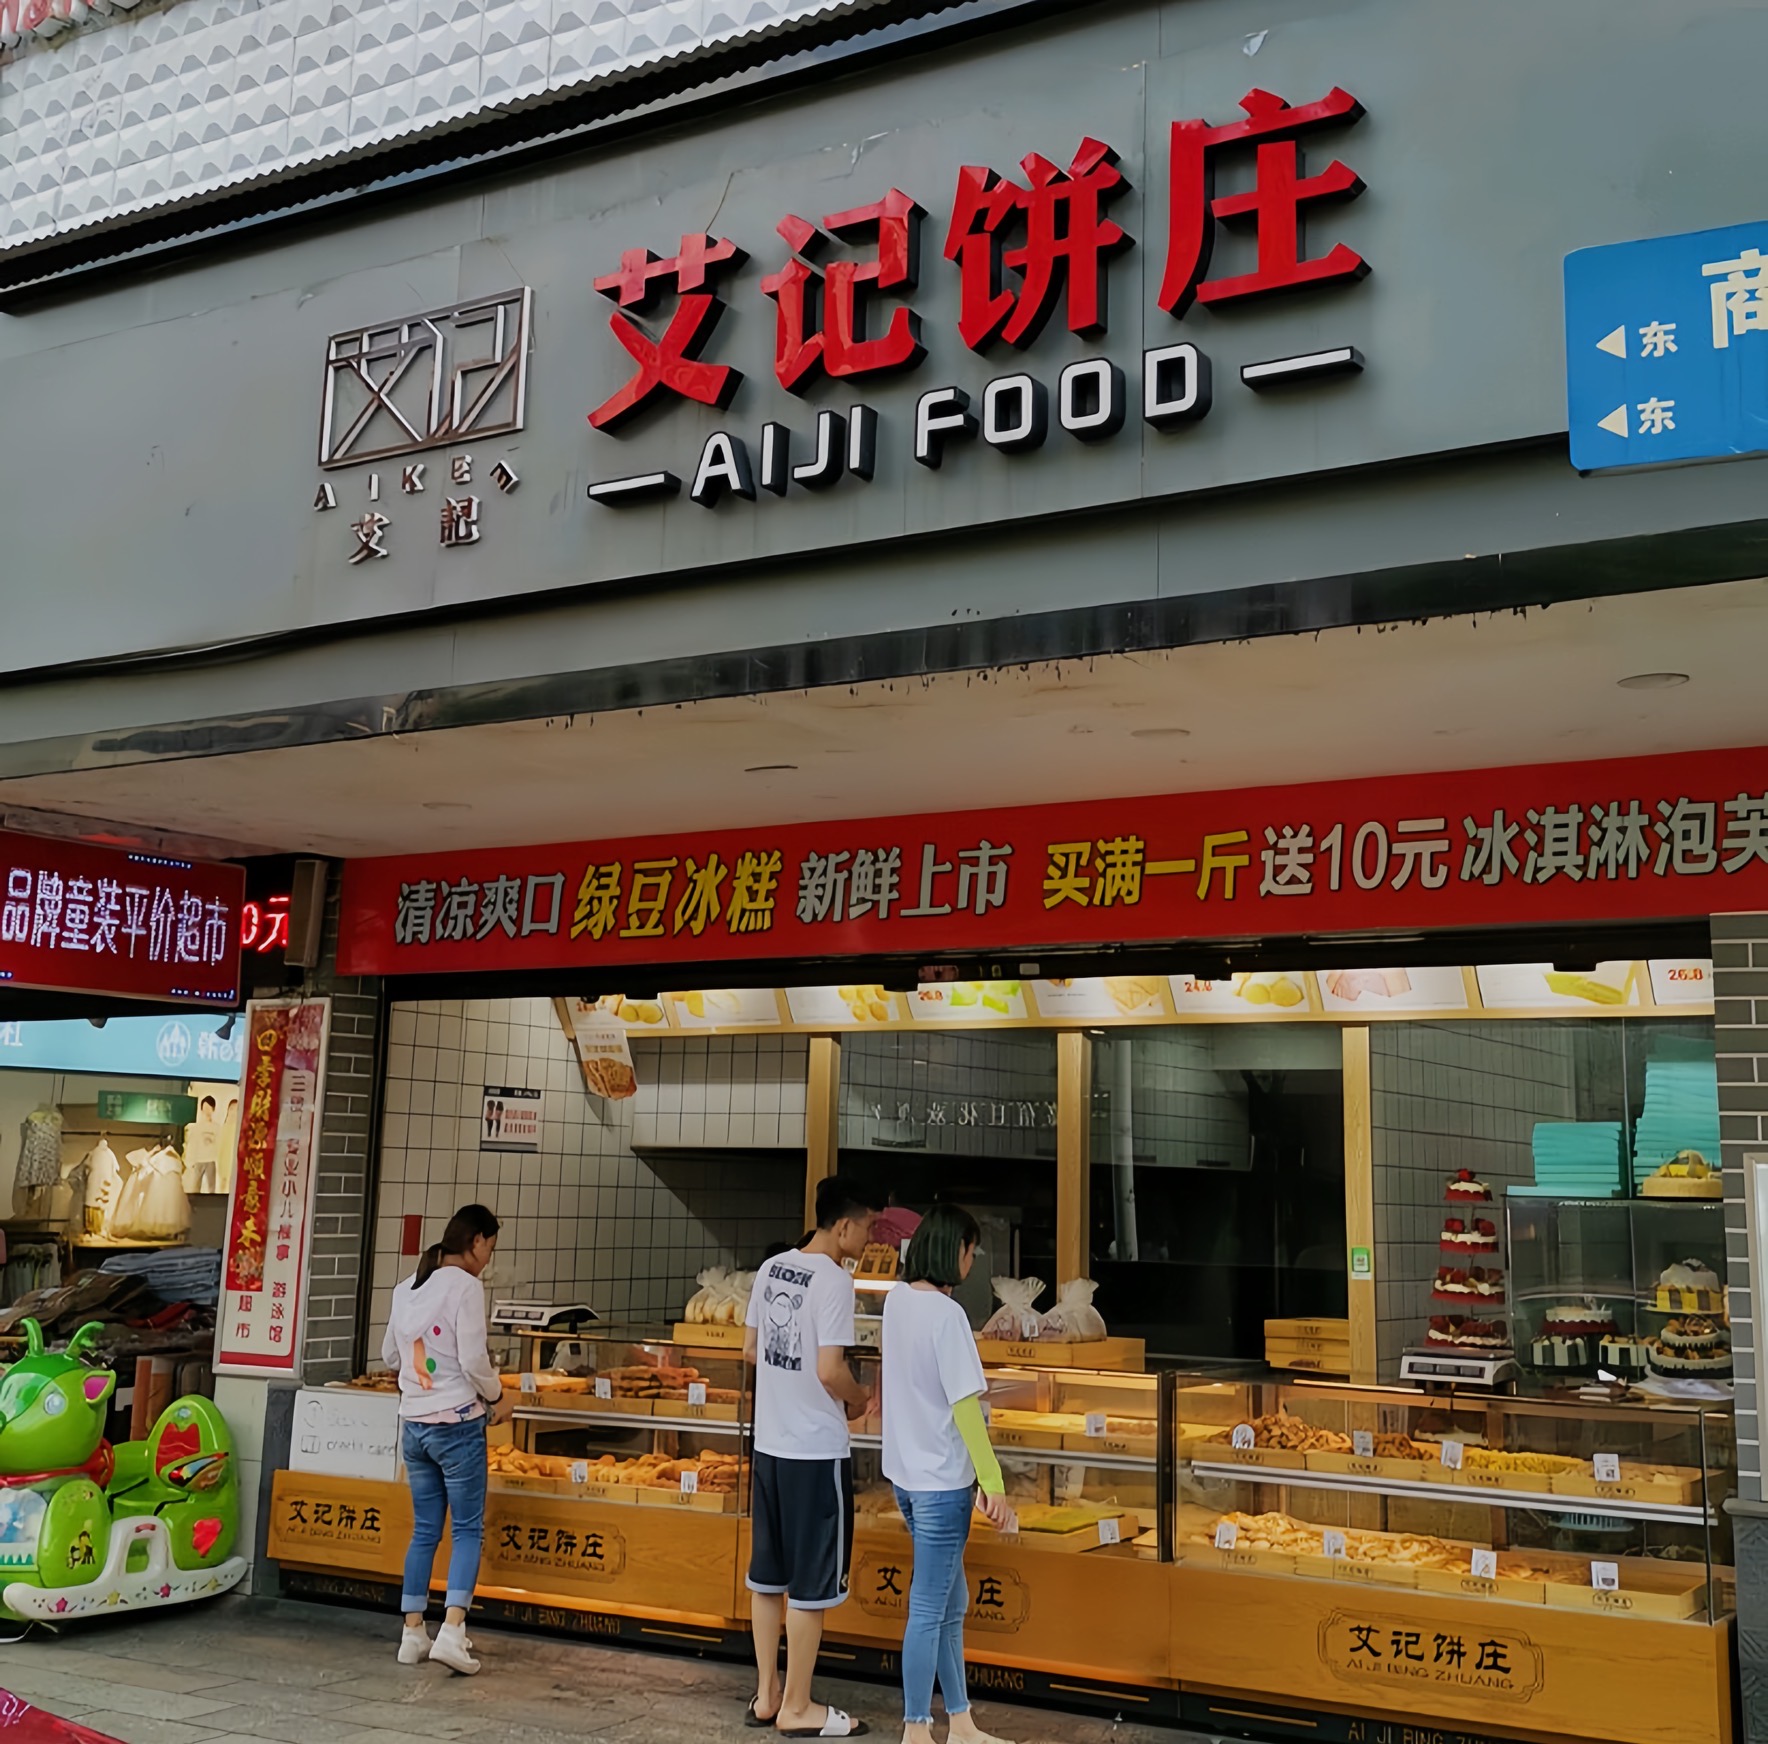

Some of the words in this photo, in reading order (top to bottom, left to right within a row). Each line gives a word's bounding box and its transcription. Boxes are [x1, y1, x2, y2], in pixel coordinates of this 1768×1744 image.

[587, 86, 1368, 430] 艾记饼庄
[1638, 321, 1678, 357] 东
[690, 403, 874, 502] AIJI
[915, 343, 1205, 464] FOOD
[1637, 397, 1676, 434] 东
[394, 871, 566, 944] 清凉爽口
[569, 849, 782, 940] 绿豆冰糕
[796, 839, 1013, 923] 新鲜上市
[1042, 830, 1250, 909] 买满一斤
[1, 866, 230, 966] 品牌童装平价超市
[288, 1500, 381, 1532] 艾记饼庄
[500, 1524, 604, 1560] 艾记饼庄
[876, 1566, 1004, 1608] 艾庄
[1349, 1625, 1512, 1674] 艾记饼庄
